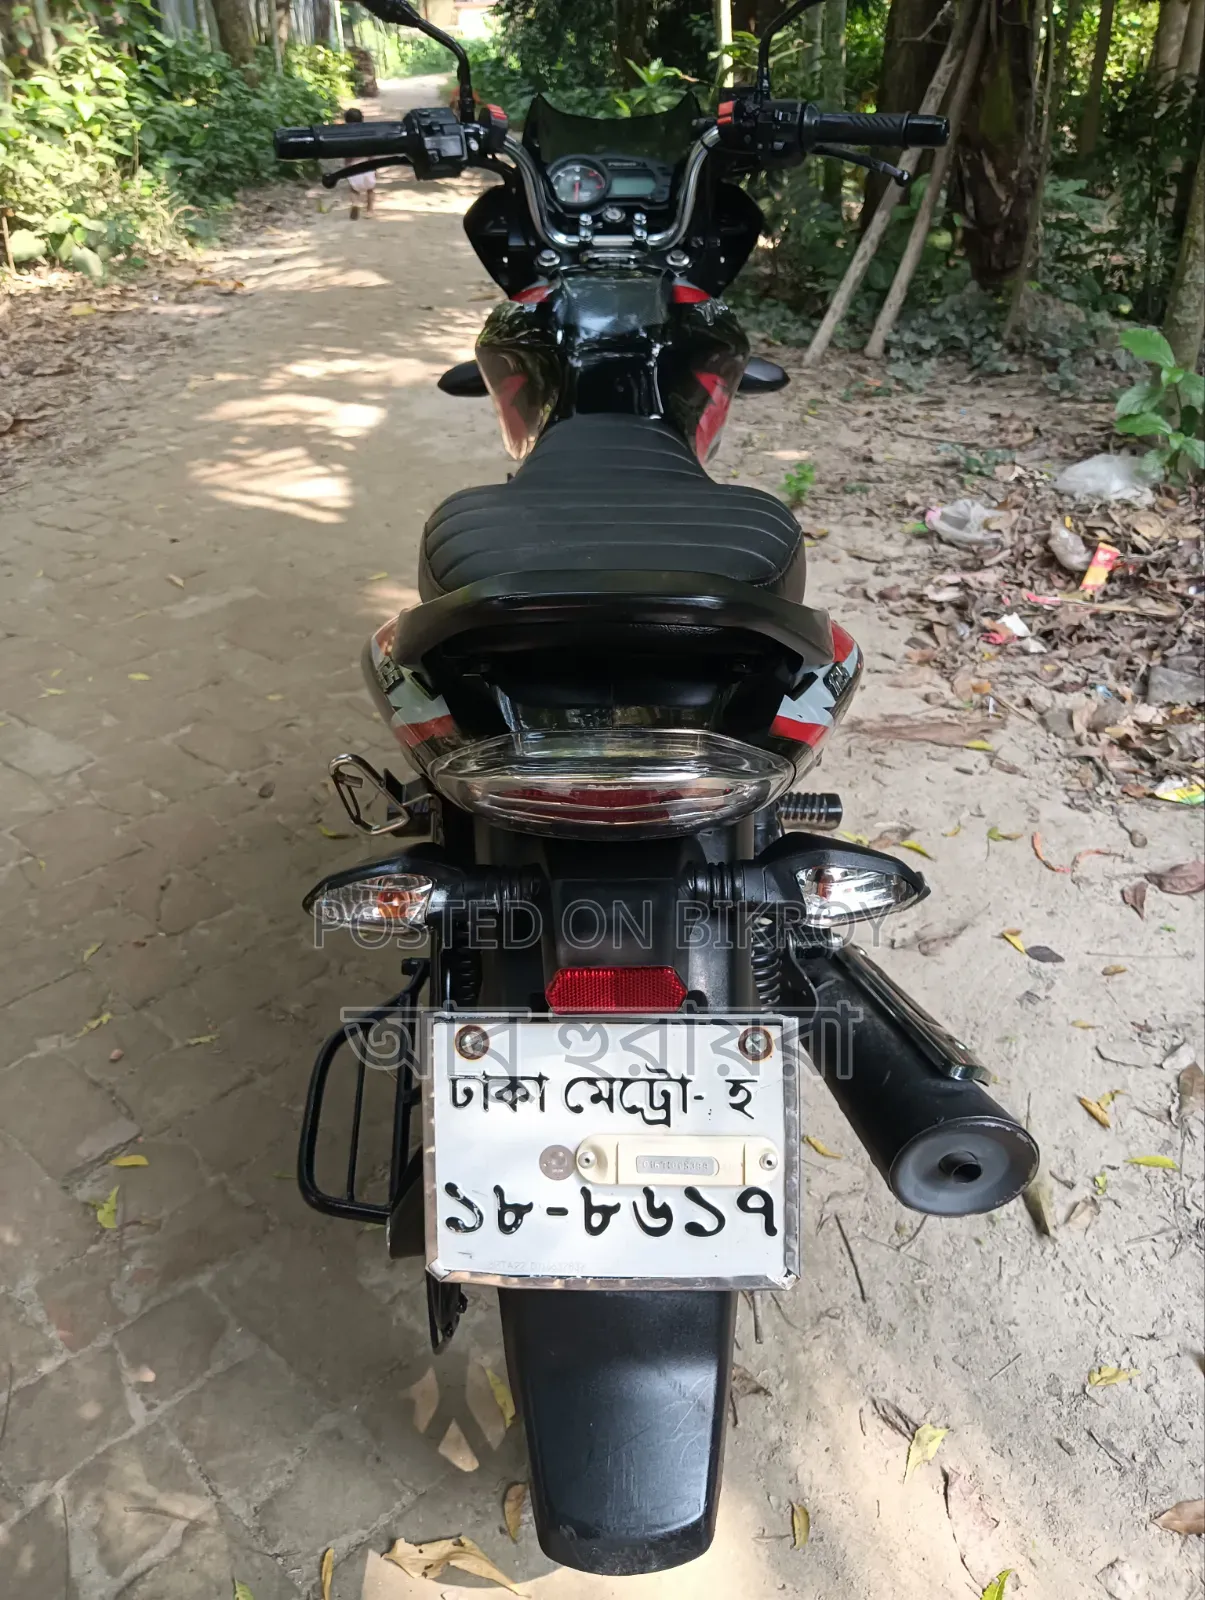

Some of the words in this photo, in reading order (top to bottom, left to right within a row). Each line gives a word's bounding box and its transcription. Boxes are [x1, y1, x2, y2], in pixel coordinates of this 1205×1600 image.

[449, 1071, 550, 1113] ঢাকা
[725, 1079, 758, 1119] হ
[445, 1181, 778, 1237] ১৮-৮৬১৭
